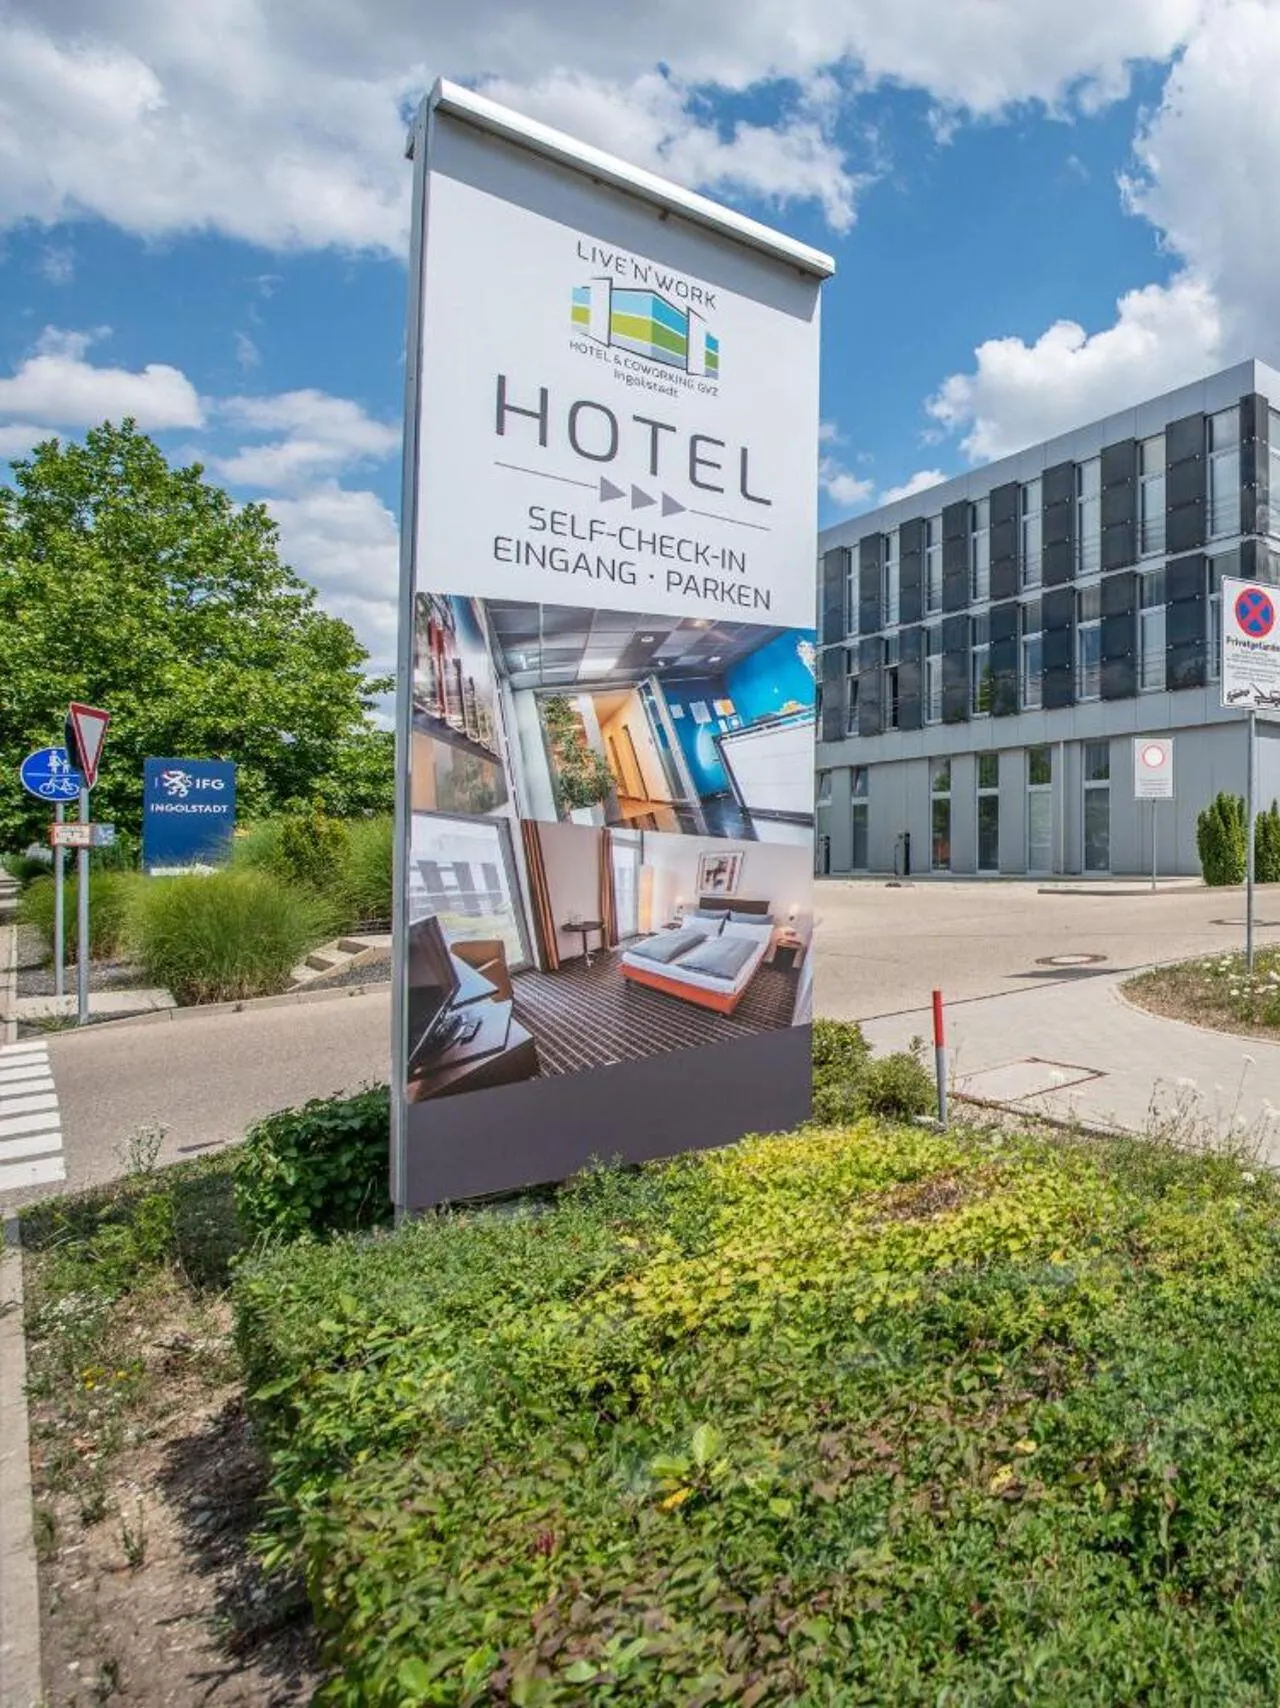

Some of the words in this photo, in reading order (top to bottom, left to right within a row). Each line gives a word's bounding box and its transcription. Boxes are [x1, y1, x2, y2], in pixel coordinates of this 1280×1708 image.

[569, 340, 611, 363] HOTEL
[613, 357, 622, 366] &
[623, 360, 695, 390] COWORKING
[614, 369, 679, 398] Ingolstadt
[496, 373, 772, 507] HOTEL
[528, 505, 746, 574] SELF-CHECK-IN
[493, 536, 636, 586] EINGANG
[666, 570, 772, 611] PARKEN
[151, 803, 229, 813] INGOLSTADT
[195, 778, 225, 791] IFG
